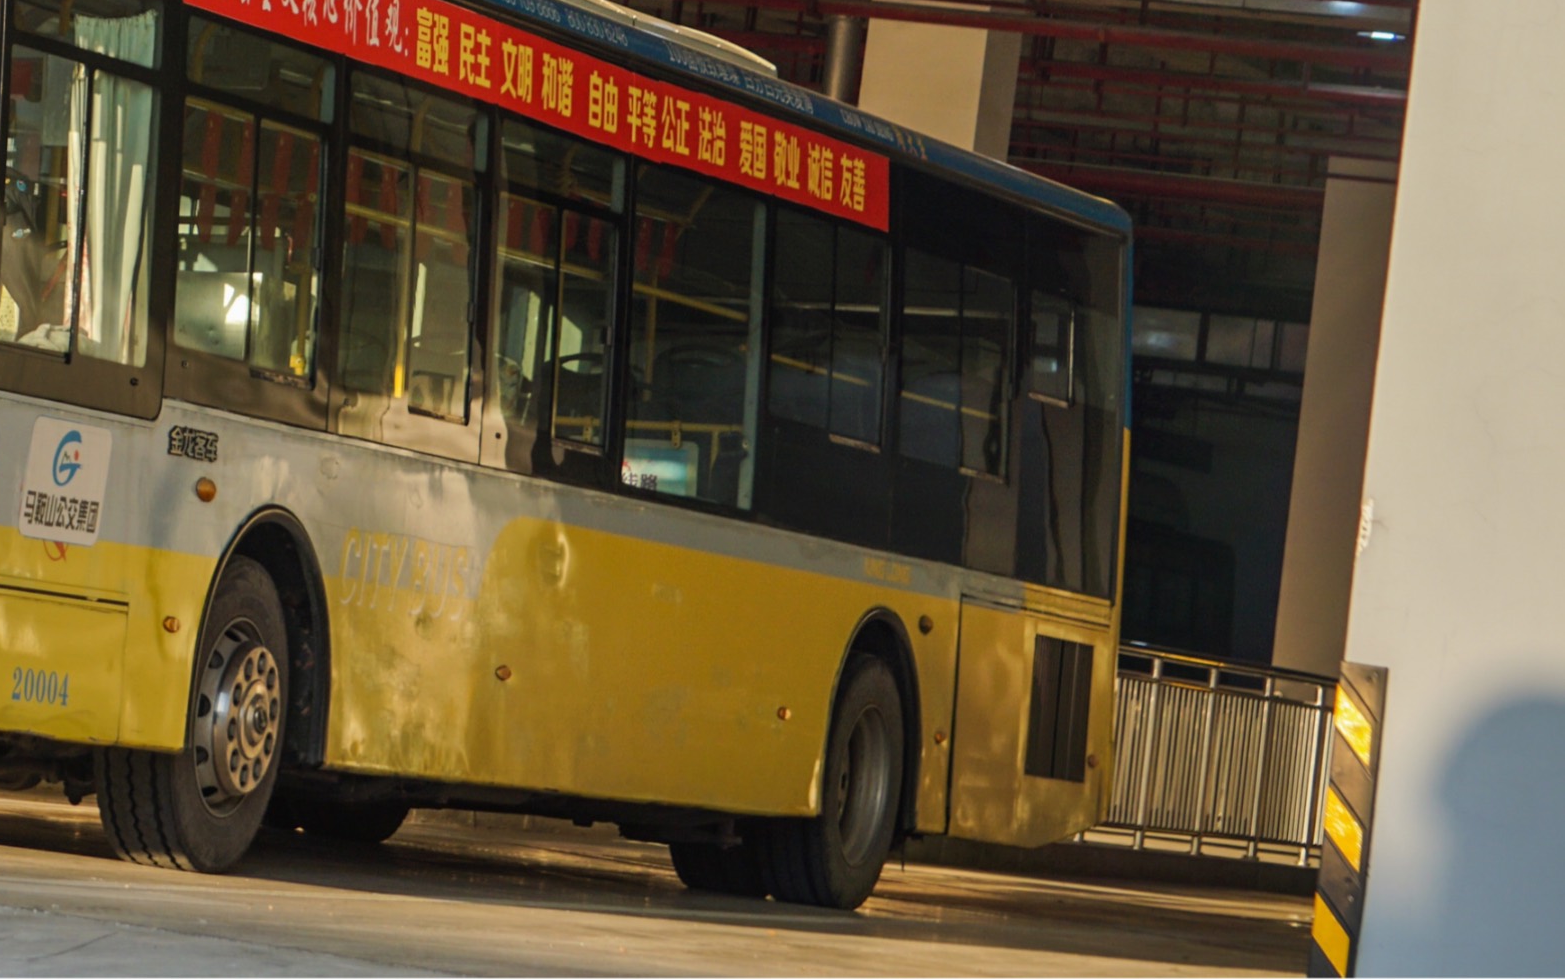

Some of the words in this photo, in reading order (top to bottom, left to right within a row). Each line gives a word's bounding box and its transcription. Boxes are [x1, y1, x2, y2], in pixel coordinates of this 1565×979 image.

[416, 6, 449, 76] 富强
[459, 22, 492, 89] 民主
[500, 37, 533, 103] 文明
[541, 52, 574, 117] 和谐
[588, 69, 619, 134] 自由
[626, 85, 658, 149] 平等
[661, 94, 690, 156] 公正
[697, 105, 726, 167] 法治
[739, 119, 767, 180] 爱国
[773, 129, 800, 190] 敬业
[807, 141, 833, 202] 诚信
[839, 152, 866, 212] 友善
[168, 425, 219, 462] 金龙客车
[24, 490, 100, 534] 马鞍山公交集团
[339, 525, 409, 611] CITY
[408, 537, 469, 622] BUS
[11, 666, 69, 707] 20004
